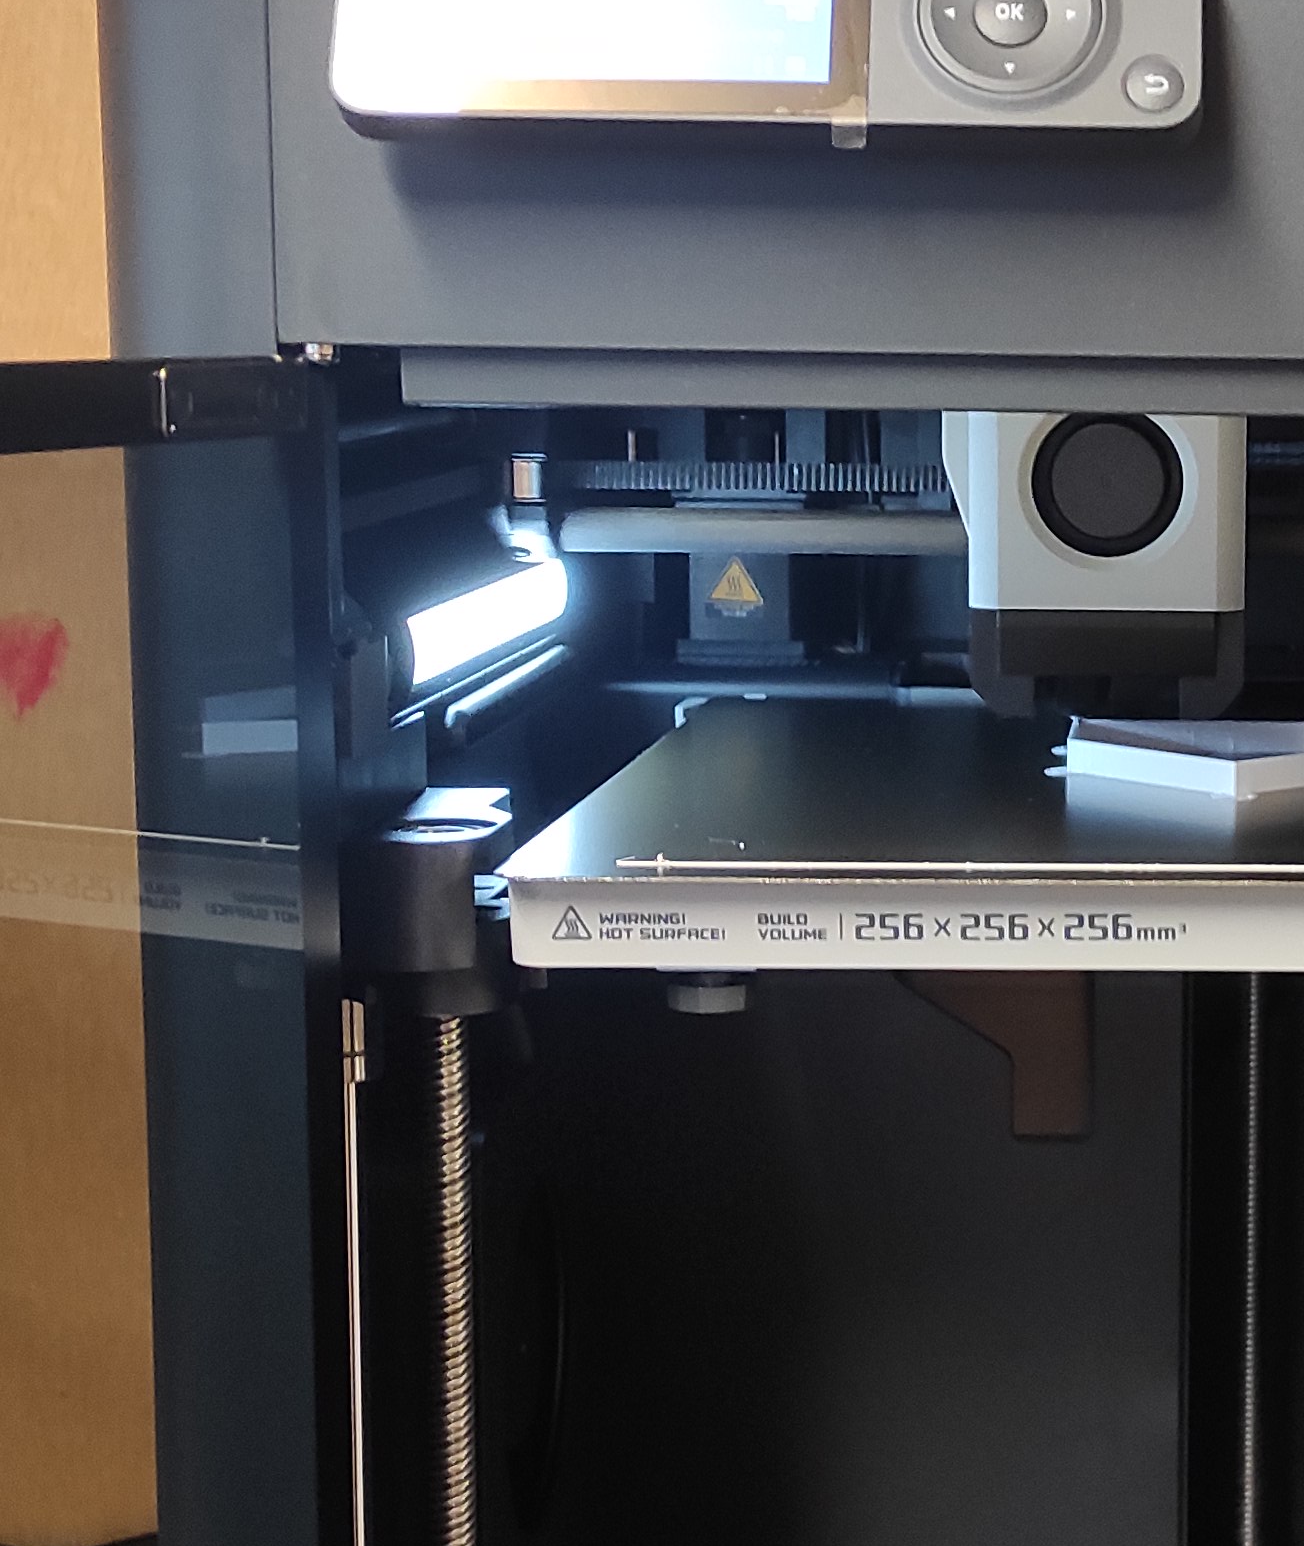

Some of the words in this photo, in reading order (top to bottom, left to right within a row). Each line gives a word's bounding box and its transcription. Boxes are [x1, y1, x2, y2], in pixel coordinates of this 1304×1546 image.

[995, 2, 1024, 21] OK
[599, 912, 686, 926] WARNING!
[757, 912, 808, 926] BUILD
[599, 927, 634, 941] HOT
[640, 927, 726, 941] SURFACE!
[757, 927, 827, 941] VOLUME
